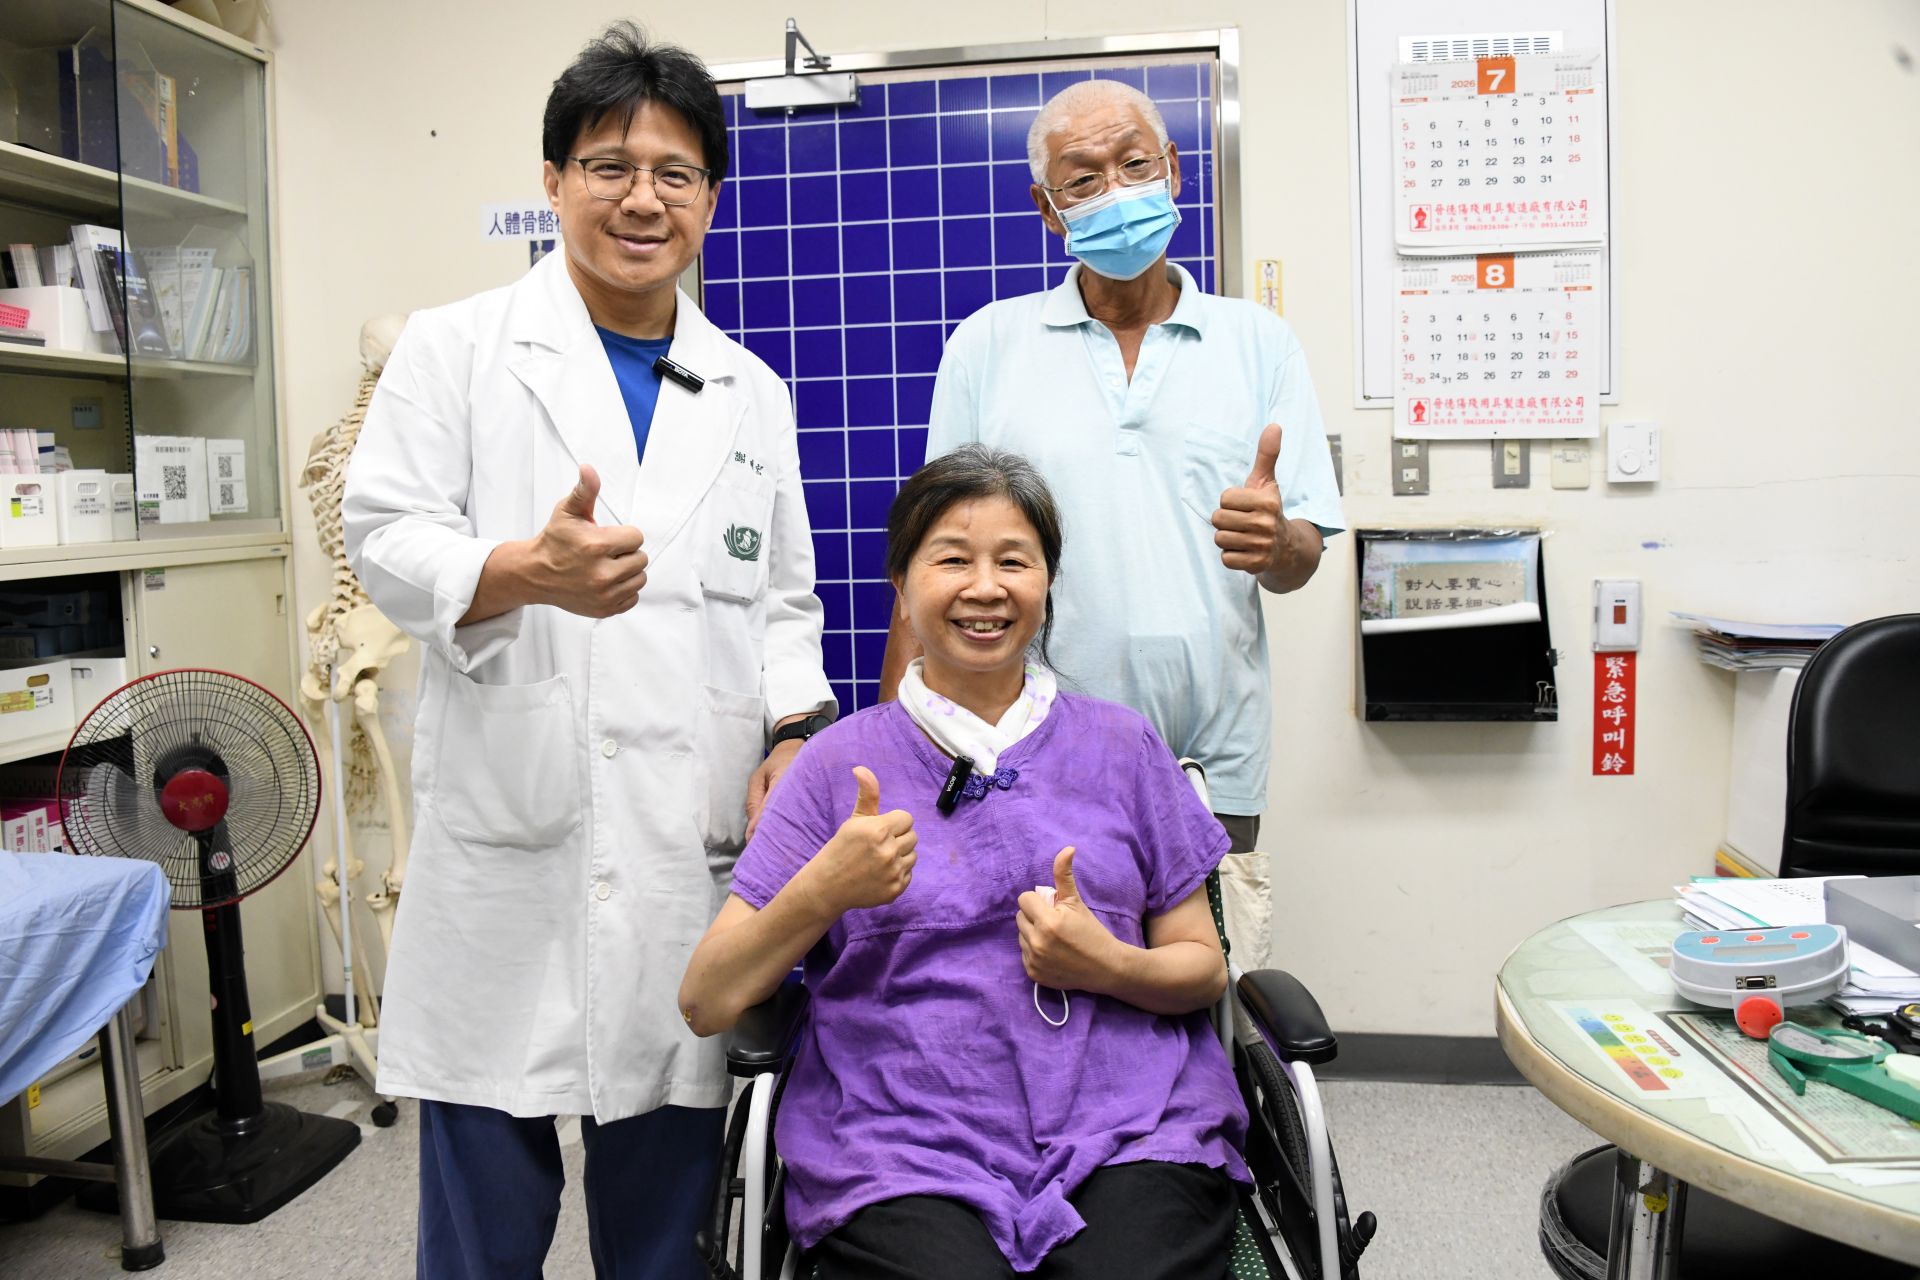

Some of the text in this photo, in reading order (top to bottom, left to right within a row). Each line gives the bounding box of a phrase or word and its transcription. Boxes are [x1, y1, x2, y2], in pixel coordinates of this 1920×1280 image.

[1451, 80, 1476, 88] 2026
[1486, 69, 1506, 91] 7
[1485, 100, 1490, 109] 1
[1403, 123, 1409, 131] 5
[1458, 159, 1468, 167] 21
[1486, 158, 1497, 166] 22
[1568, 154, 1581, 162] 25
[1404, 180, 1416, 188] 26
[1432, 179, 1442, 187] 27
[1459, 178, 1470, 186] 28
[1486, 177, 1497, 185] 29
[1513, 176, 1525, 184] 30
[489, 210, 561, 236] 人體骨骼
[1485, 264, 1505, 286] 8
[1403, 315, 1409, 323] 2
[1430, 315, 1436, 323] 3
[1484, 314, 1490, 322] 5
[1565, 312, 1572, 320] 8
[1567, 331, 1578, 339] 15
[1511, 352, 1523, 360] 20
[1566, 351, 1577, 359] 22
[1457, 372, 1468, 380] 25
[1566, 370, 1578, 378] 29
[1602, 656, 1628, 773] 緊急呼叫鈴
